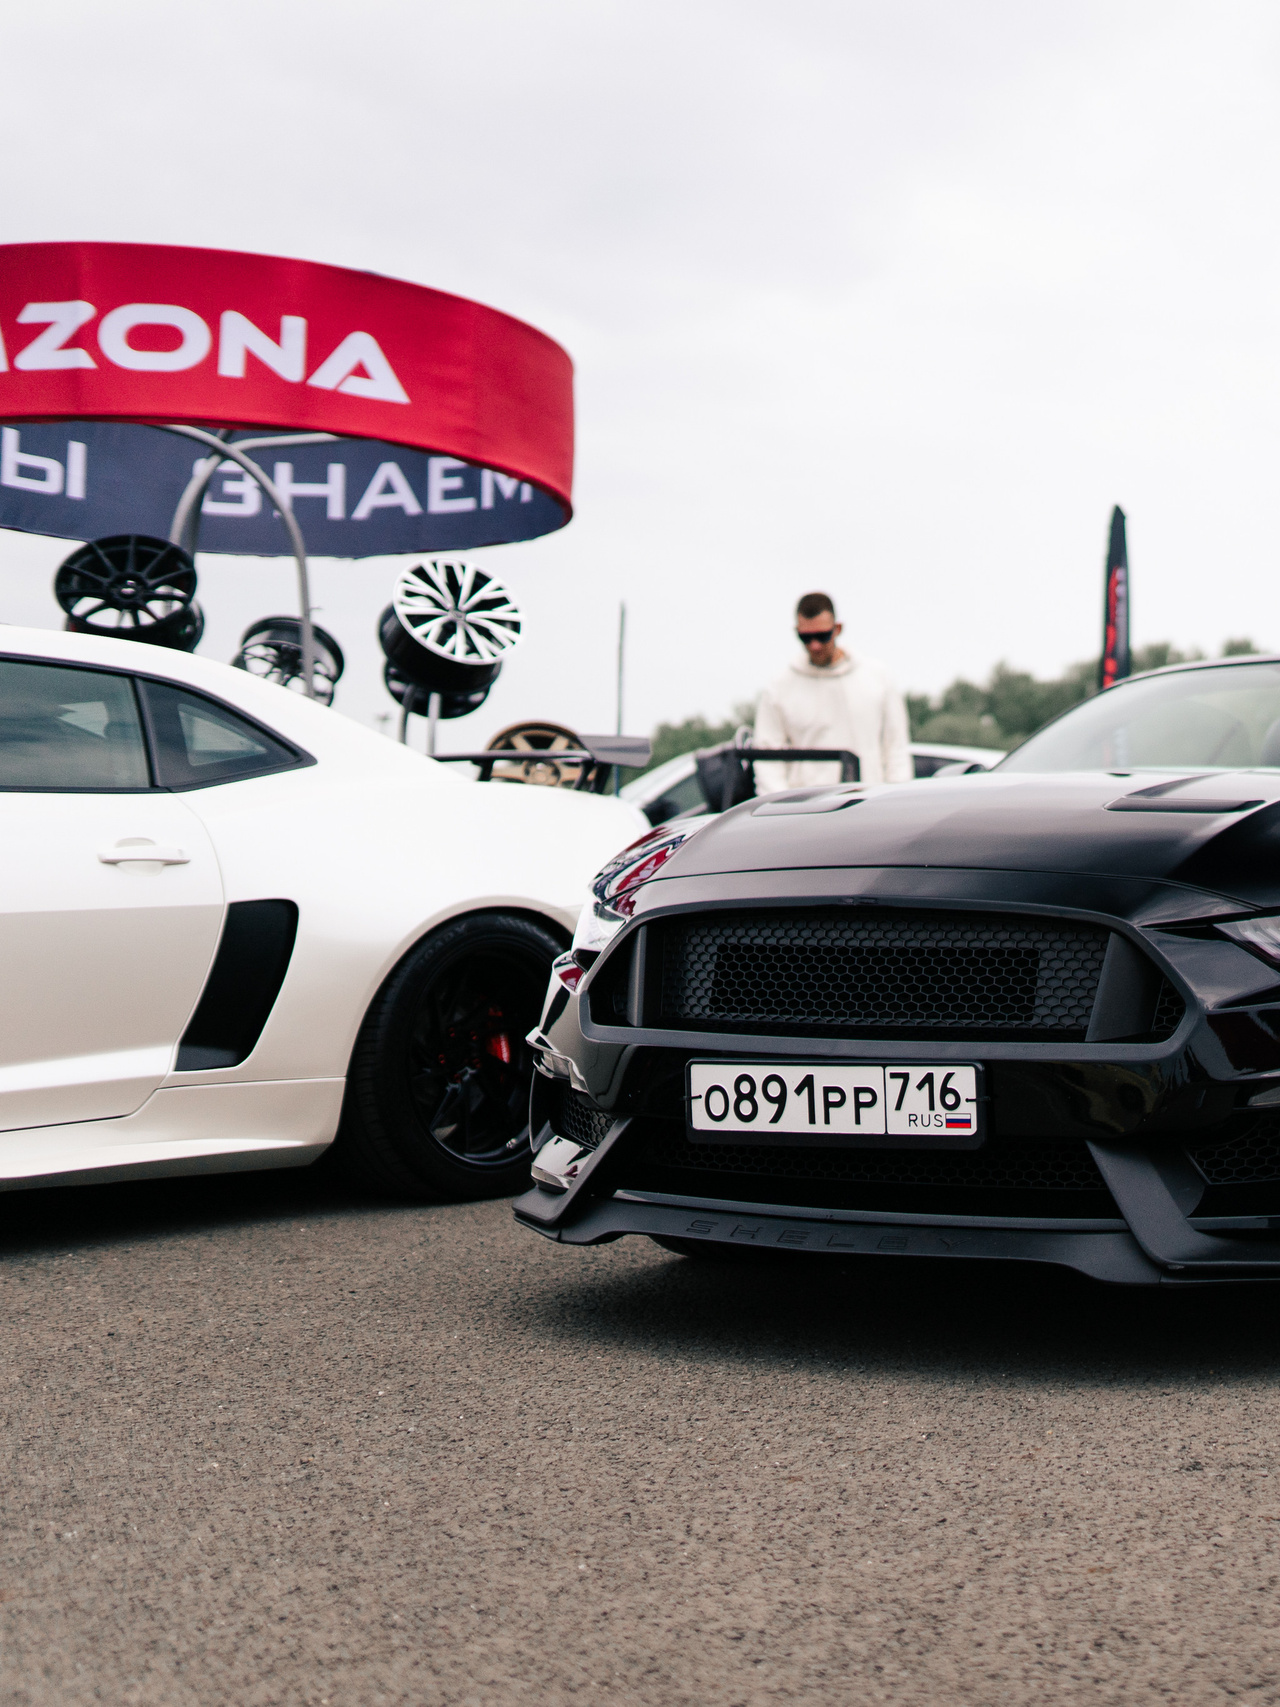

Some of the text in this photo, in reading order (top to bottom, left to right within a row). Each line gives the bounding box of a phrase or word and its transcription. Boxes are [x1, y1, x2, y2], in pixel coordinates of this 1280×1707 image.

[0, 300, 411, 404] ZONA
[889, 1071, 962, 1112] 716
[908, 1113, 943, 1128] RUS
[686, 1219, 972, 1251] SHELBY
